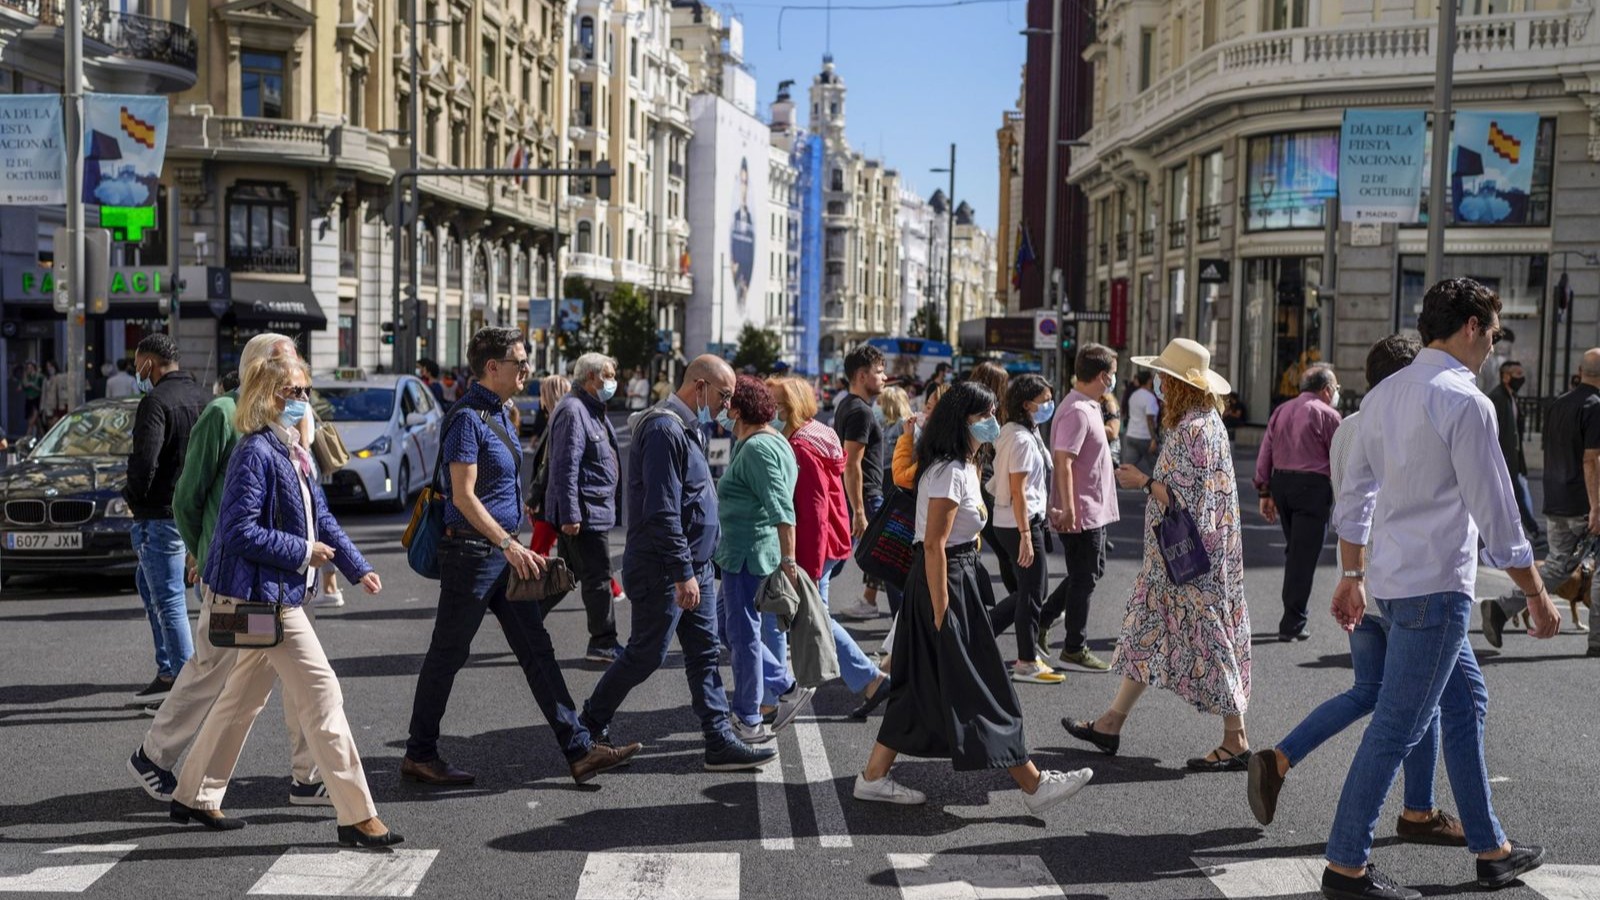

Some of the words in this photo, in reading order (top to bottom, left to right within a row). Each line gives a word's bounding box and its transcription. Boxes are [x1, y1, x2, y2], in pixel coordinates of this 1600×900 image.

[14, 108, 32, 119] DE
[34, 108, 50, 119] LA
[0, 124, 32, 134] ESTA
[1350, 123, 1373, 136] DÍA
[1375, 124, 1394, 136] DE
[1396, 124, 1414, 136] LA
[0, 138, 58, 149] ACIONAL
[1348, 139, 1391, 151] FIESTA
[6, 158, 15, 168] 12
[17, 158, 32, 168] DE
[1347, 154, 1417, 166] NACIONAL
[6, 170, 61, 180] OCTUBRE
[1361, 173, 1369, 183] 12
[1371, 174, 1387, 184] DE
[1359, 187, 1414, 197] OCTUBRE
[22, 272, 161, 294] FAACI
[16, 535, 49, 547] 6077
[54, 535, 79, 547] JXM
